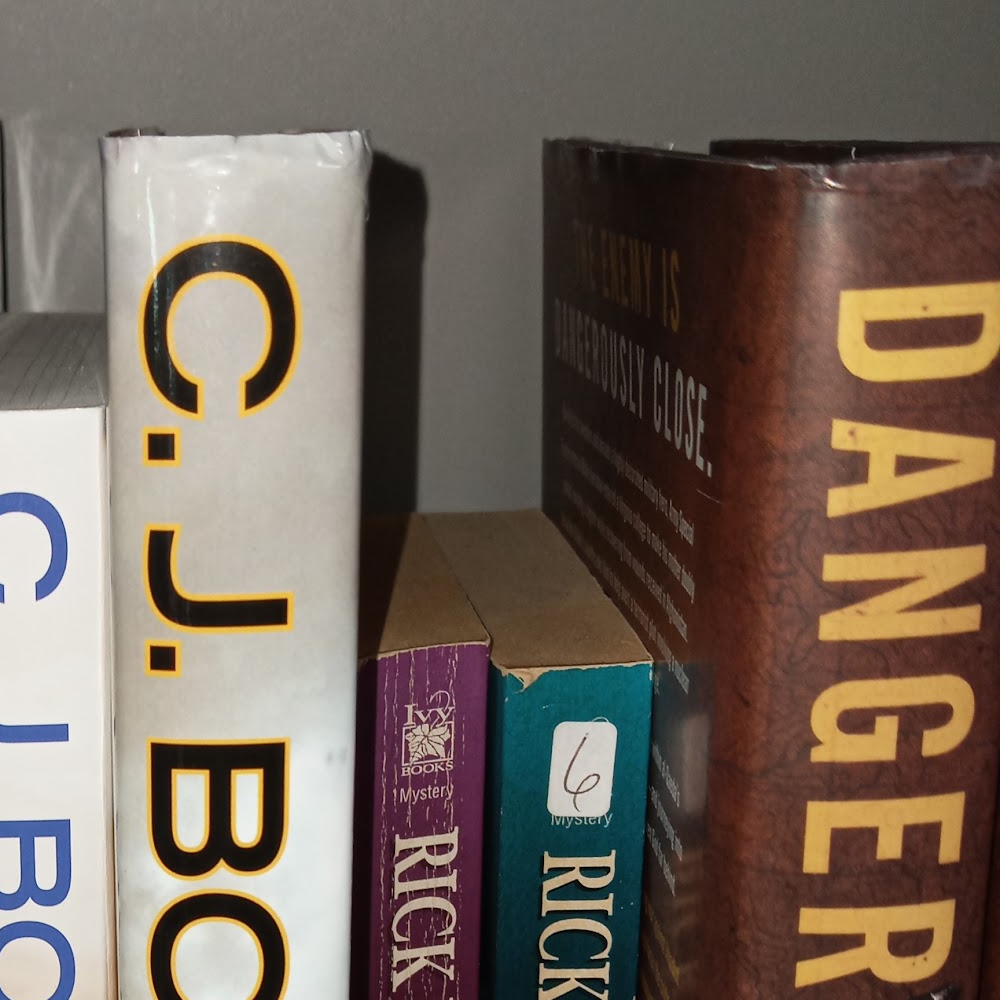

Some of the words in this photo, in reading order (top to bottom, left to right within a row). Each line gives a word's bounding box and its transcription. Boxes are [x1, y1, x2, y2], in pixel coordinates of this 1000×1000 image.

[137, 235, 303, 469] C.
[661, 247, 680, 333] IS
[555, 297, 645, 420] DANGEROUSLY
[653, 354, 713, 479] CLOSE.
[143, 523, 294, 678] J.
[794, 281, 1000, 989] DANGER
[399, 782, 455, 805] Mystery
[400, 760, 454, 777] BOOKS
[562, 732, 602, 813] 6
[389, 825, 459, 994] RICK
